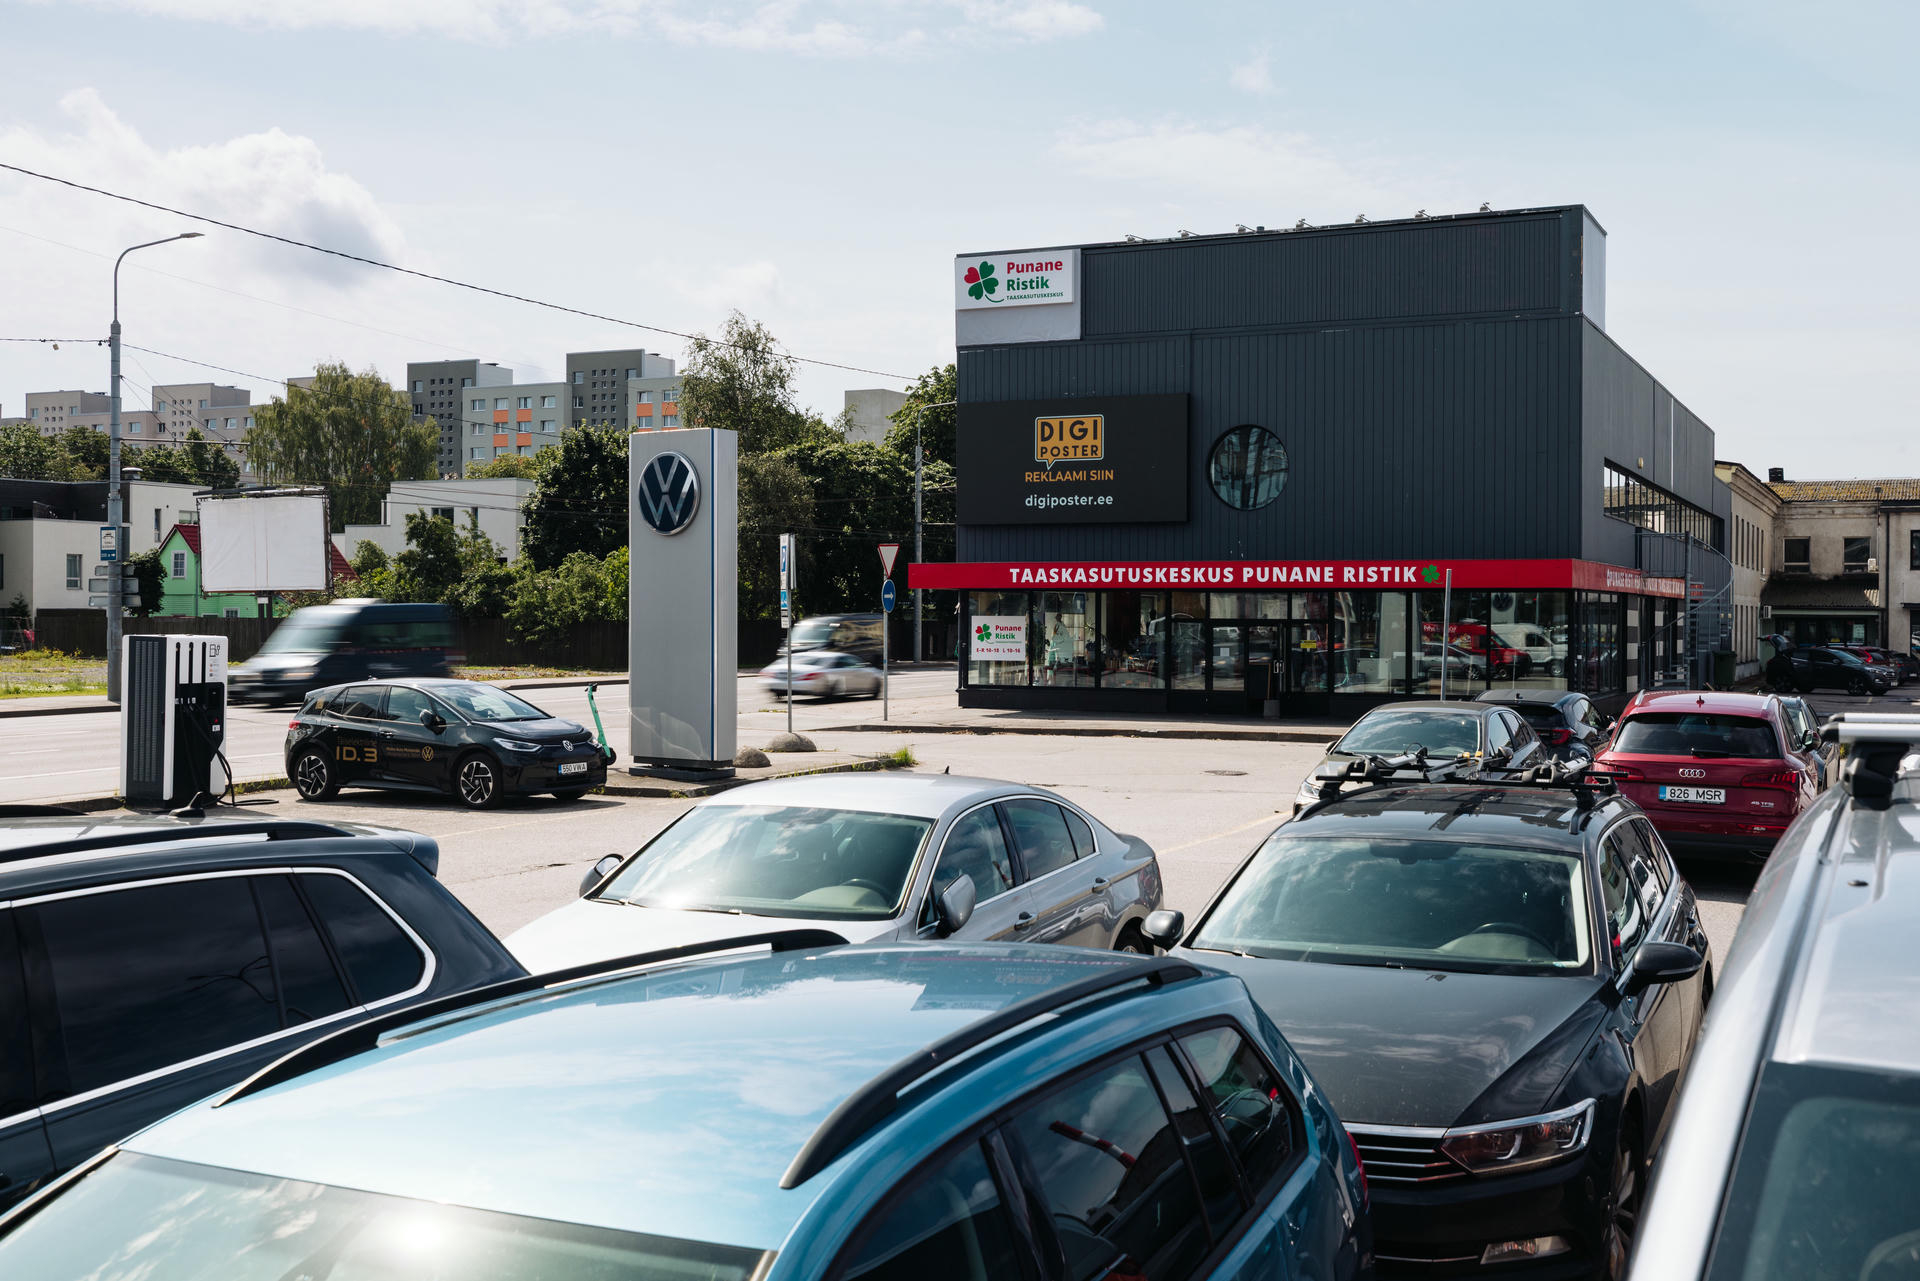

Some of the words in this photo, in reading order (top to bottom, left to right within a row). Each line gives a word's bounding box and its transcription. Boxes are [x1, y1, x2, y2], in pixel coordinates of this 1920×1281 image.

[1007, 260, 1063, 274] Punane
[1007, 276, 1050, 291] Ristik
[1007, 292, 1064, 300] TAASKASUTUSKESKUS
[1040, 419, 1098, 442] DIGI
[1040, 445, 1099, 458] POSTER
[1025, 471, 1087, 482] REKLAAMI
[1090, 470, 1114, 481] SIIN
[1025, 494, 1113, 509] digiposter.ee
[1009, 567, 1234, 583] TAASKASUTUSKESKUS
[1242, 566, 1334, 583] PUNANE
[1343, 566, 1417, 582] RISTIK
[336, 746, 377, 762] ID.3
[1669, 788, 1690, 799] 826
[1695, 789, 1722, 800] MSR
